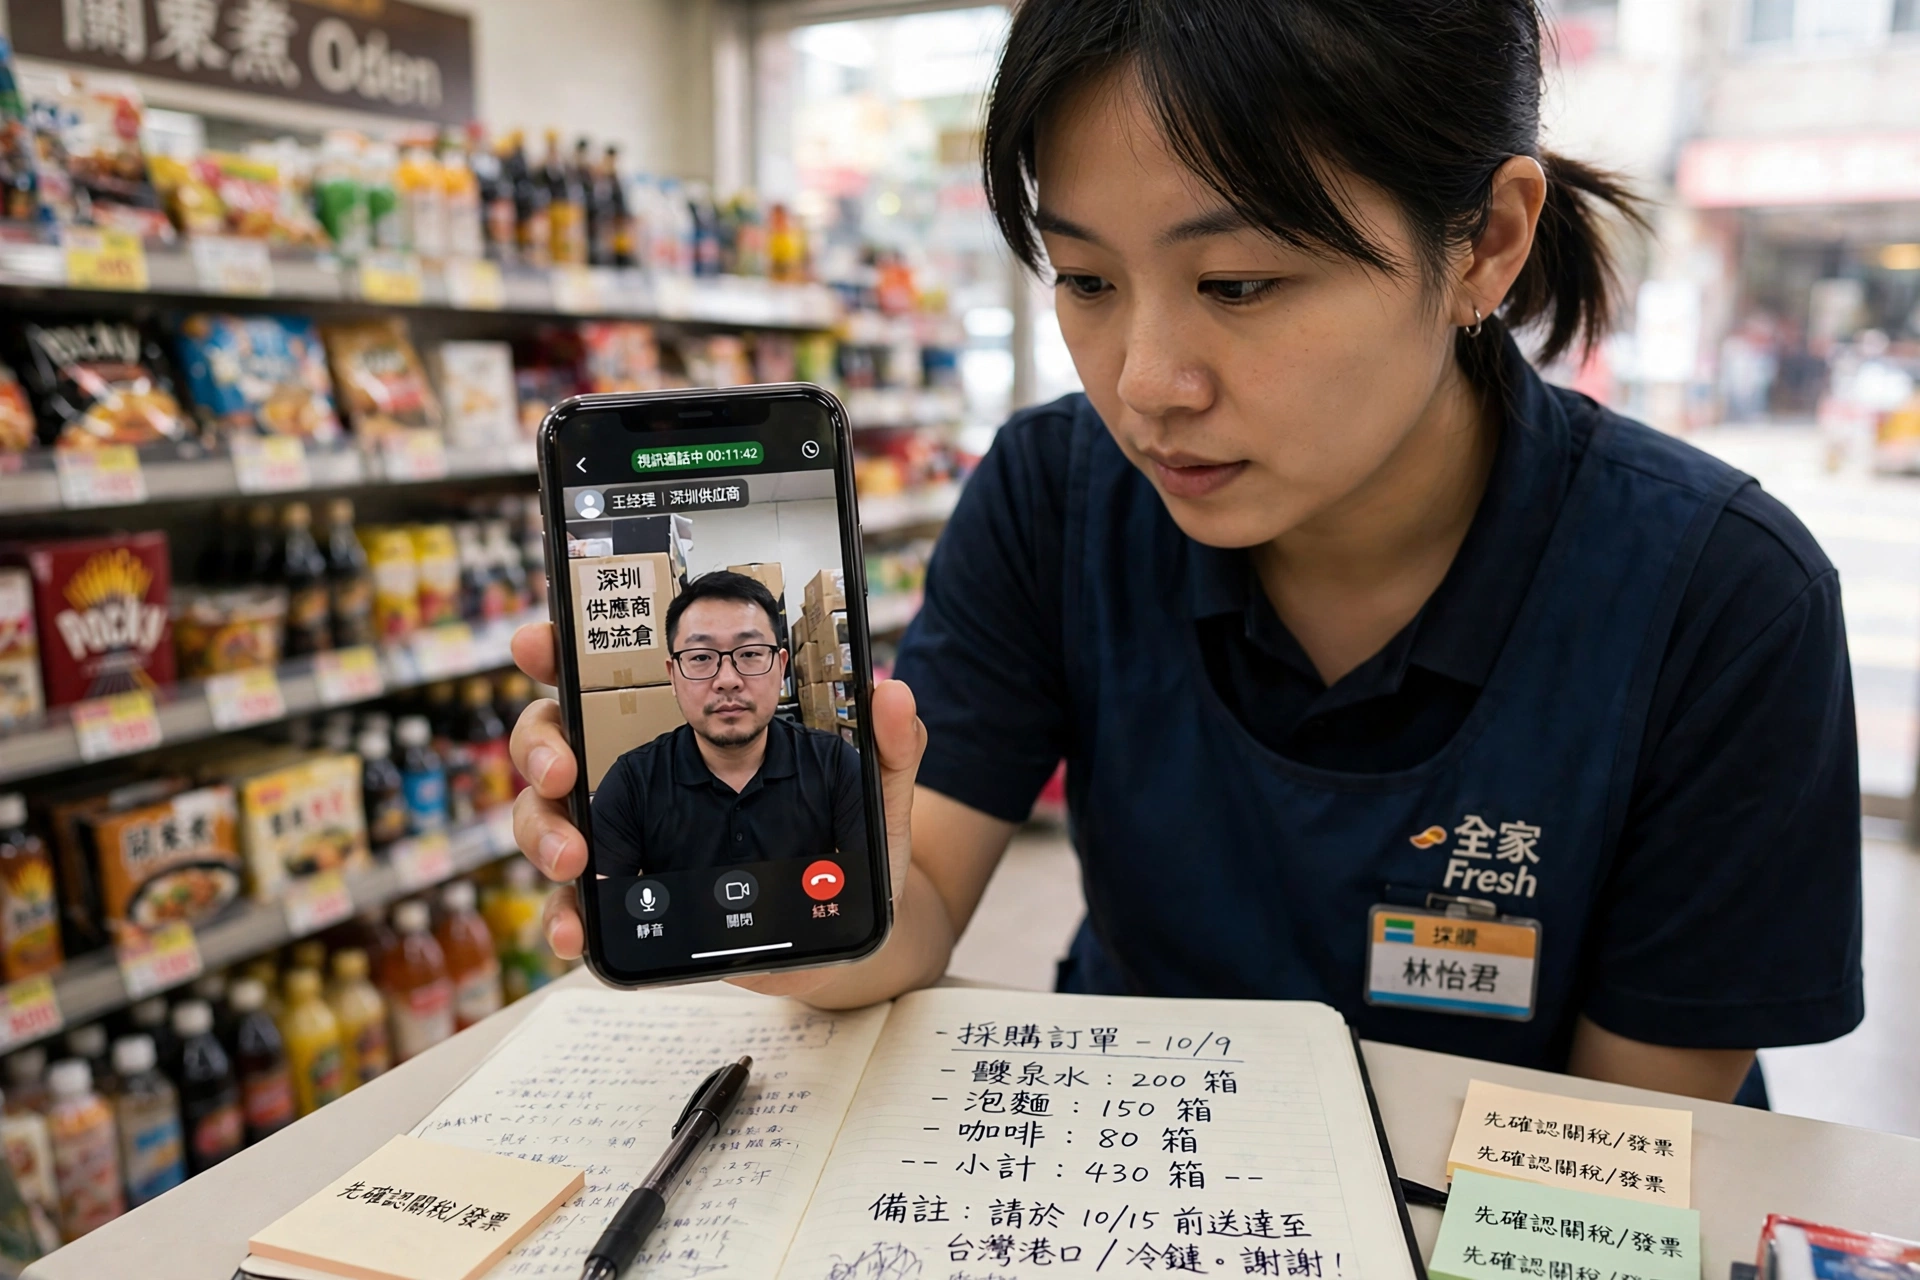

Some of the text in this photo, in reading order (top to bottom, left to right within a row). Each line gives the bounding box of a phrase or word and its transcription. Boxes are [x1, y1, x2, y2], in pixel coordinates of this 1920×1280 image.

[309, 17, 443, 107] Oden
[706, 448, 757, 461] 00:11:42
[612, 486, 740, 509] 王经理 深圳供应商
[597, 567, 641, 591] 深圳
[586, 596, 651, 621] 供應商
[588, 624, 653, 650] 物流倉
[1452, 815, 1541, 864] 全家
[1443, 858, 1538, 898] Fresh
[1402, 956, 1500, 993] 林怡君
[957, 1022, 1231, 1057] 採購訂單 10/9
[1131, 1072, 1186, 1088] 200
[1204, 1069, 1237, 1094] 箱
[1102, 1100, 1155, 1118] 150
[1177, 1097, 1211, 1123] 箱
[1098, 1129, 1138, 1148] 80
[1162, 1127, 1197, 1154] 箱
[1484, 1111, 1674, 1157] 先確認關稅/發票
[1085, 1161, 1148, 1183] 430
[1168, 1160, 1205, 1189] 箱
[1477, 1145, 1666, 1193] 先確認關稅/發票
[337, 1181, 510, 1232] 先確認關稅/發票
[1083, 1204, 1160, 1233] 10/15
[1173, 1206, 1312, 1239] 前送達至
[1474, 1205, 1683, 1258] 先確認關稅/發票
[1462, 1246, 1666, 1280] 先確認關稅
